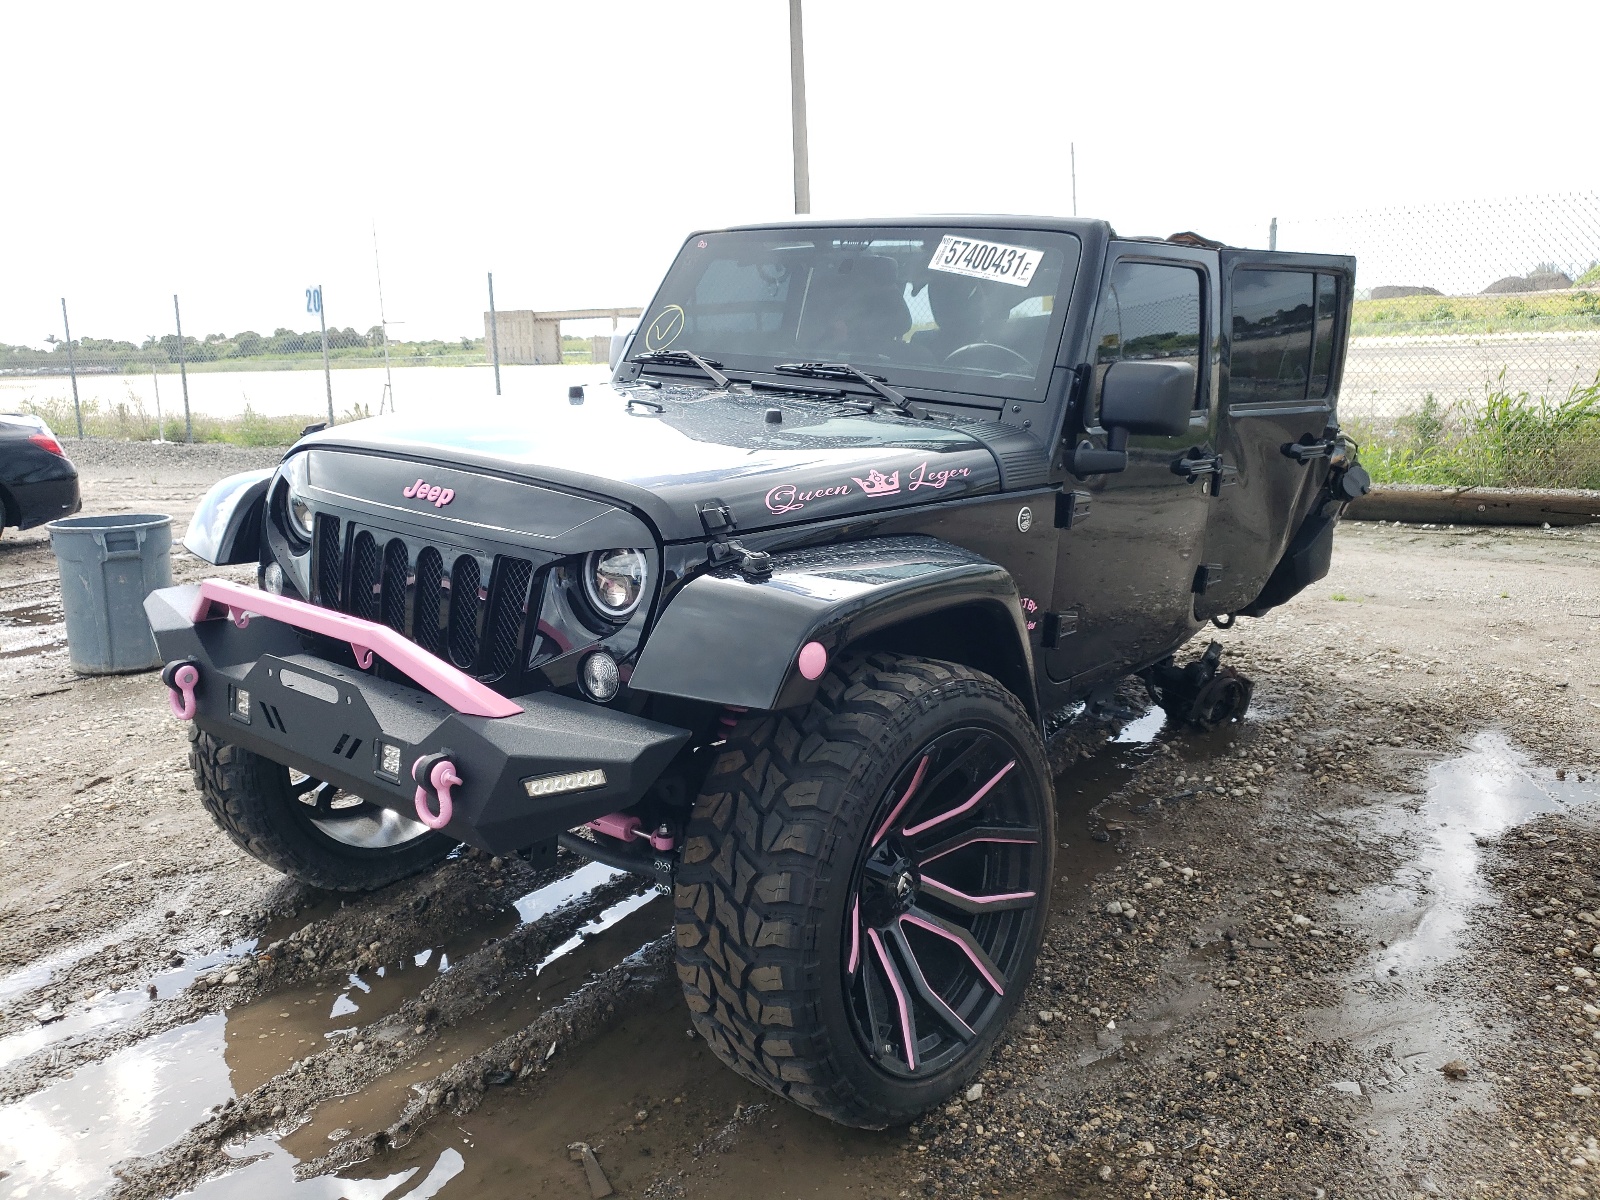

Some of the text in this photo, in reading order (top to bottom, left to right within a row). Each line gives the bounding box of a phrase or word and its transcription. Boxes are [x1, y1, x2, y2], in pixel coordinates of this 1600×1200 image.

[944, 240, 1027, 277] 57400431
[306, 289, 320, 313] 20
[403, 479, 455, 508] Jeep
[765, 462, 971, 515] Queen Leger
